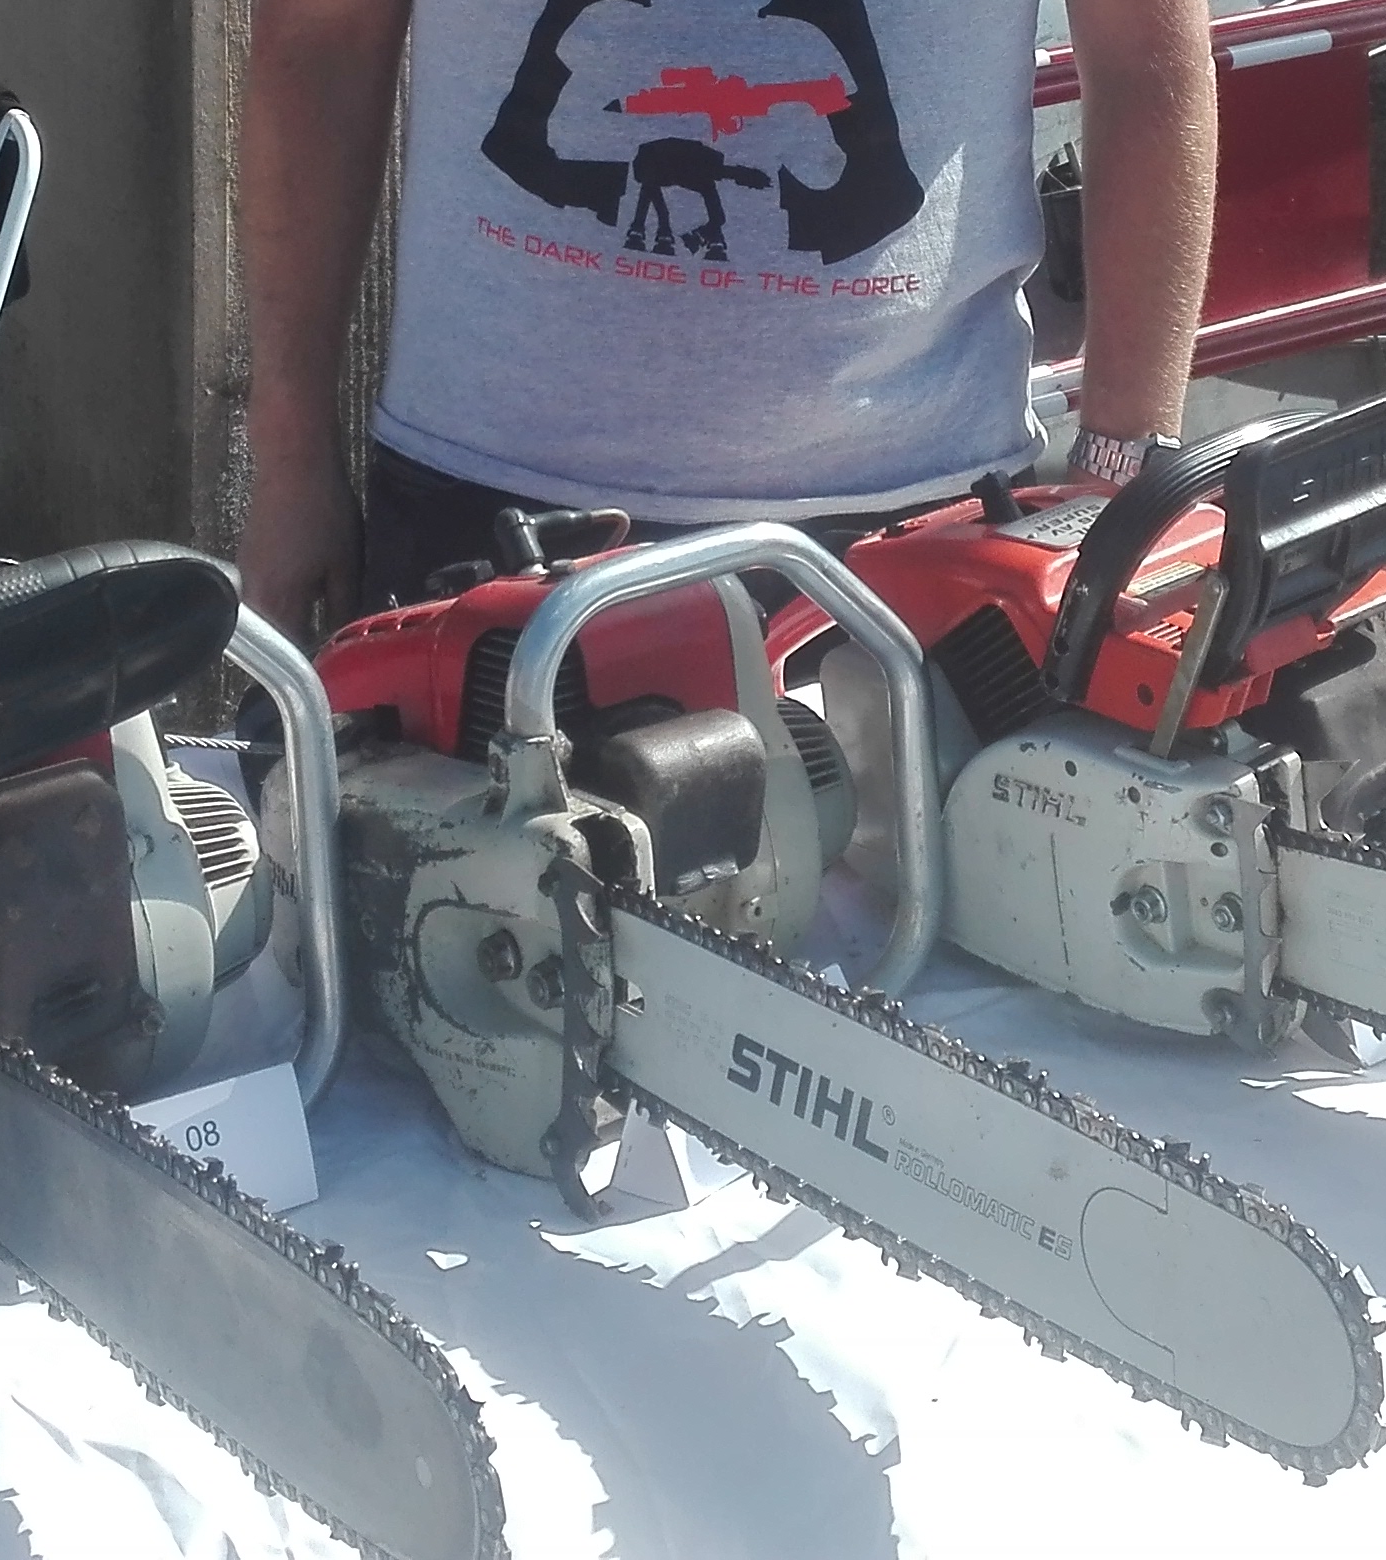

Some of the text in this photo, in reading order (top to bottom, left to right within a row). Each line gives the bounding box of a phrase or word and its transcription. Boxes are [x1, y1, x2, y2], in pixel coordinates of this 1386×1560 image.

[475, 215, 922, 297] THE DARK SIDE OF THE FORCE
[1034, 503, 1102, 533] SUPER
[992, 773, 1087, 826] STIHL
[727, 1033, 888, 1163] STIHL
[186, 1120, 221, 1152] 08
[894, 1150, 1073, 1261] ROLLOMATIC ES
